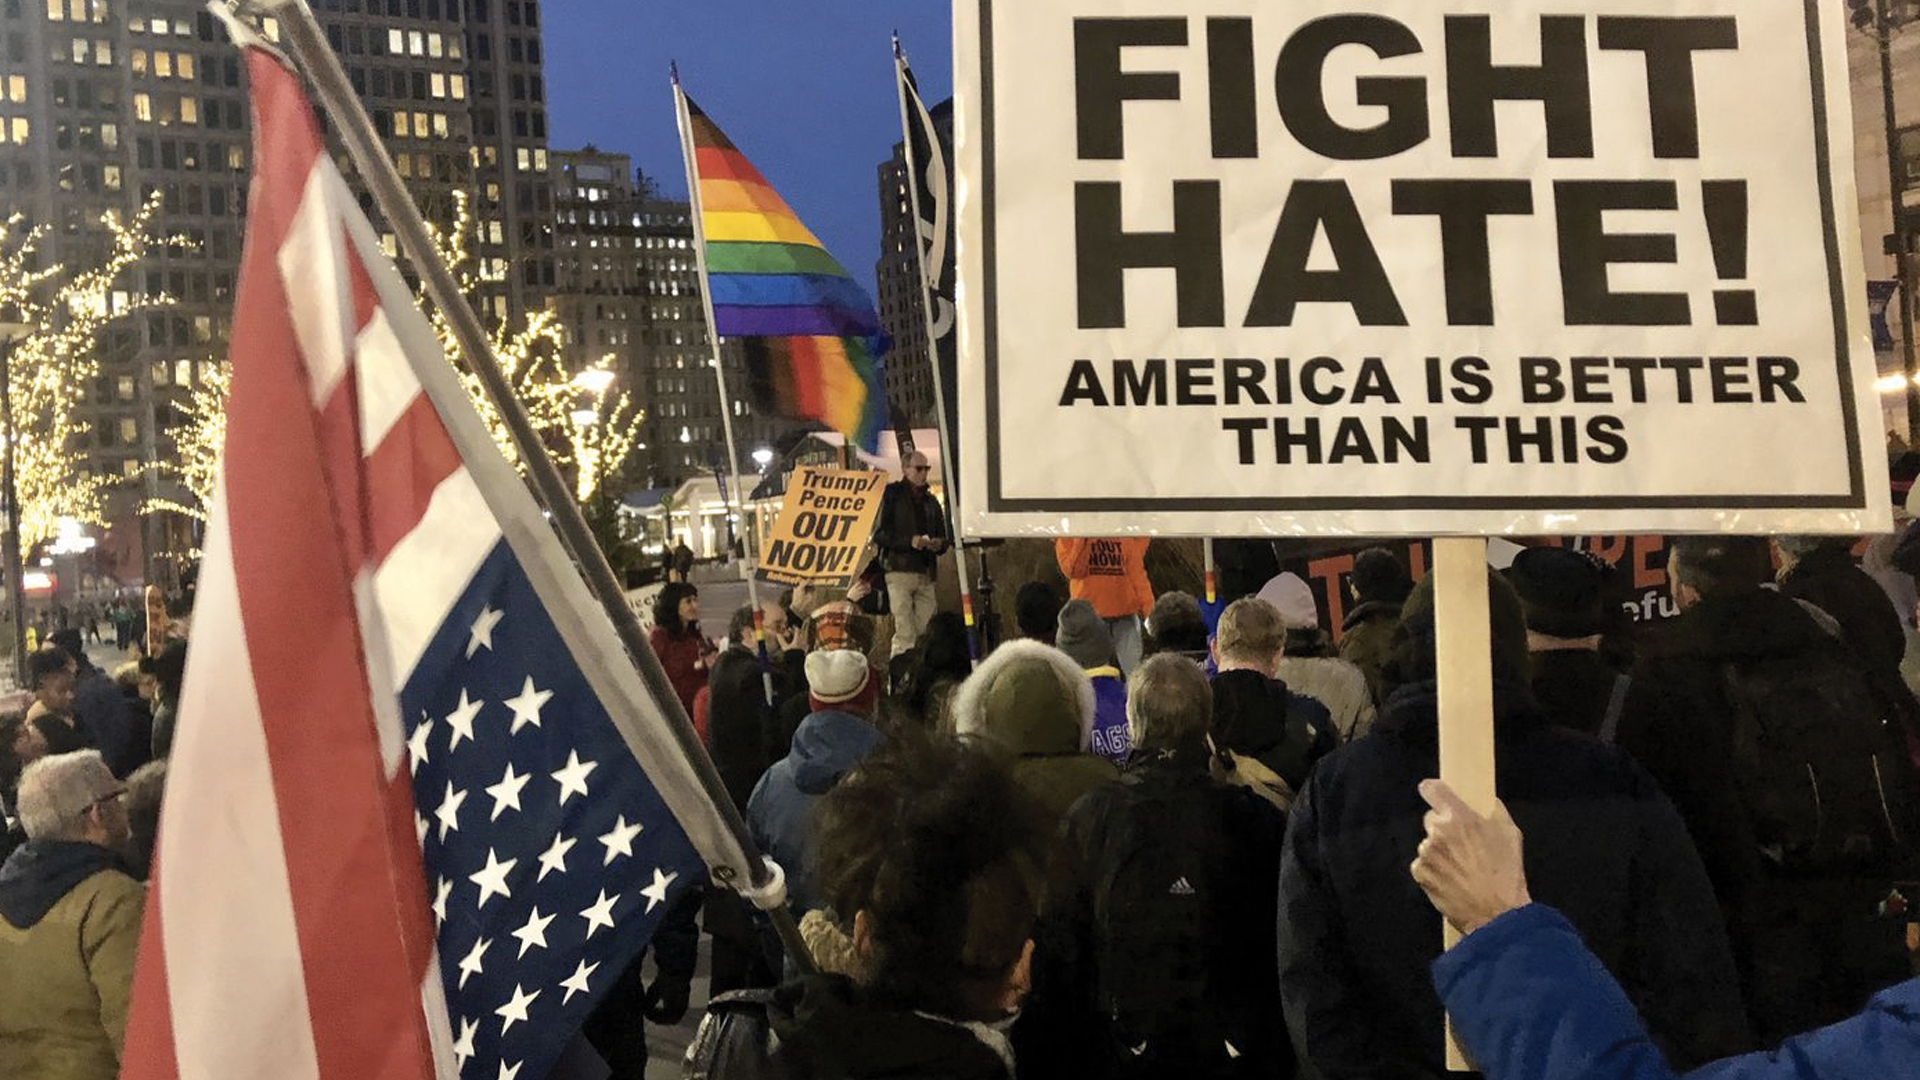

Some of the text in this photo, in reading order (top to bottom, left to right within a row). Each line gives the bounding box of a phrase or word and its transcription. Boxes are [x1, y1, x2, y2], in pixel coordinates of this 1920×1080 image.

[1073, 13, 1739, 160] FIGHT
[1074, 179, 1759, 329] HATE!
[1058, 356, 1807, 407] AMERICA IS BETTER
[1221, 414, 1629, 466] THAN THIS
[799, 490, 866, 511] Pence
[802, 470, 880, 495] Trump/
[792, 511, 859, 542] OUT
[766, 539, 857, 573] NOW!
